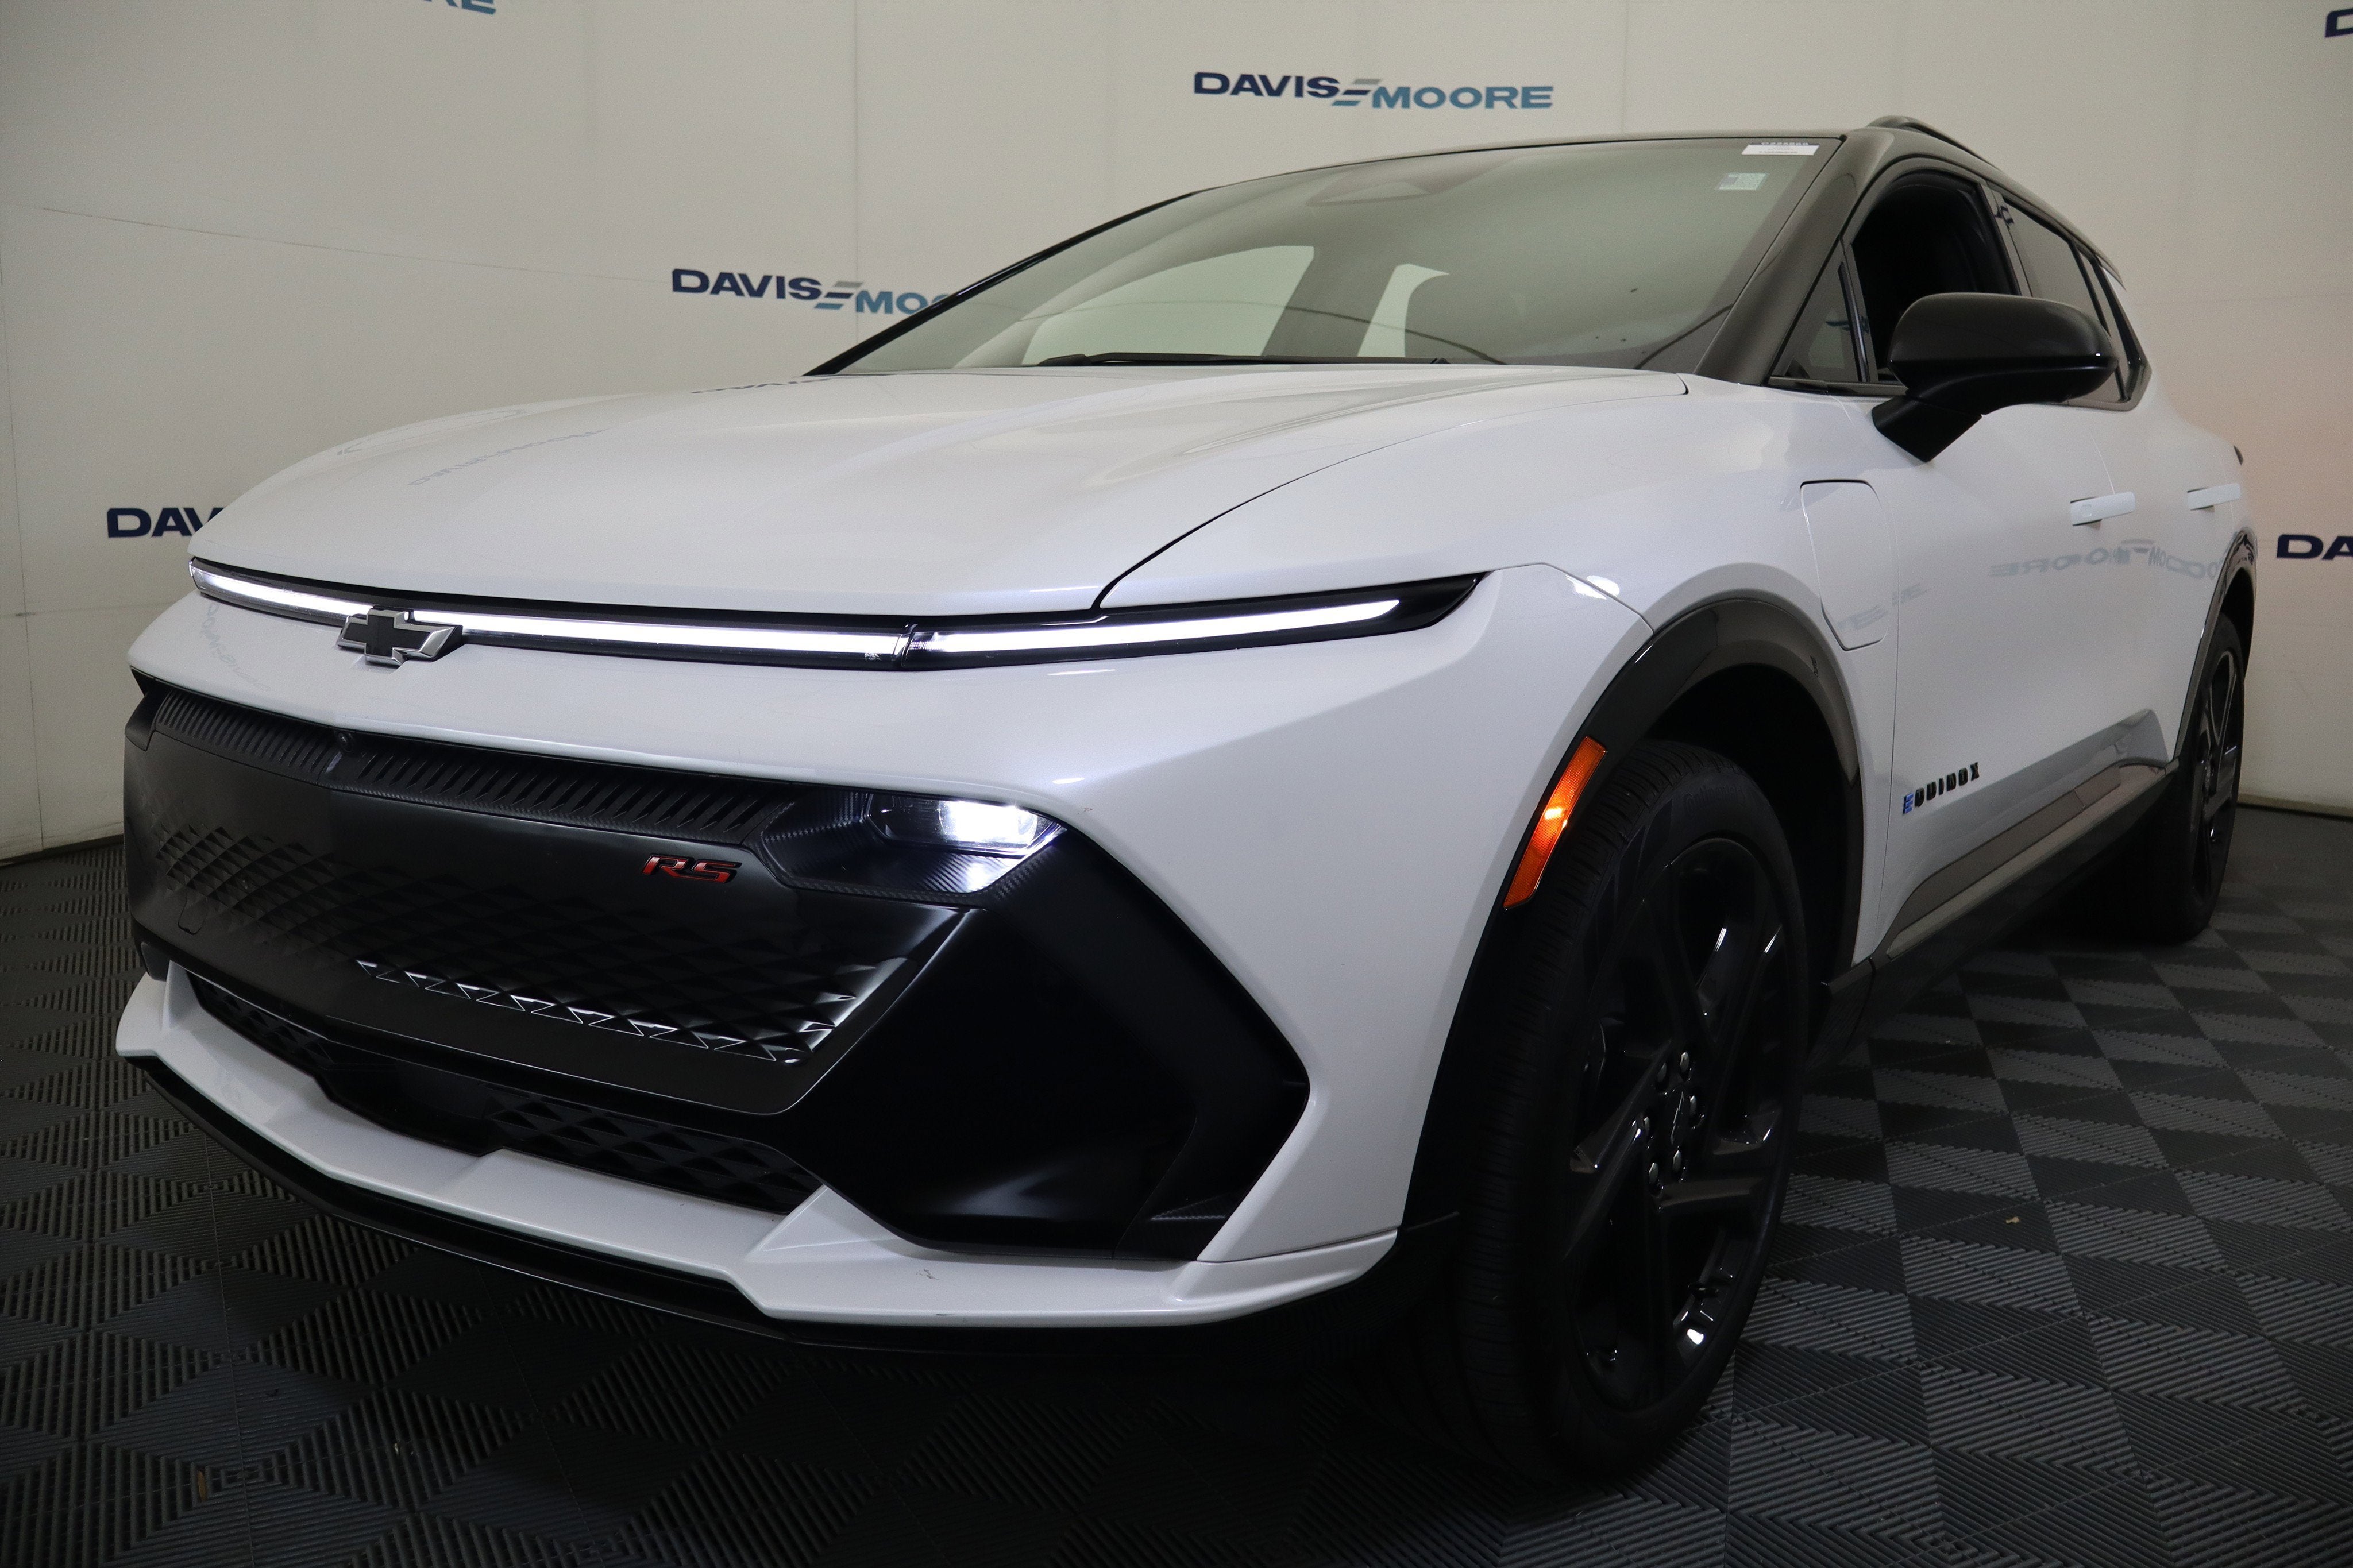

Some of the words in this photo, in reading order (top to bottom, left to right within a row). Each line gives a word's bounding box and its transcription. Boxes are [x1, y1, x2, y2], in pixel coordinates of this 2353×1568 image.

[1194, 72, 1340, 99] DAVIS
[1372, 86, 1554, 110] MOORE
[672, 268, 823, 301] DAVIS
[106, 507, 225, 539] DAV
[1902, 762, 1980, 815] EQUINOX
[641, 854, 741, 884] RS
